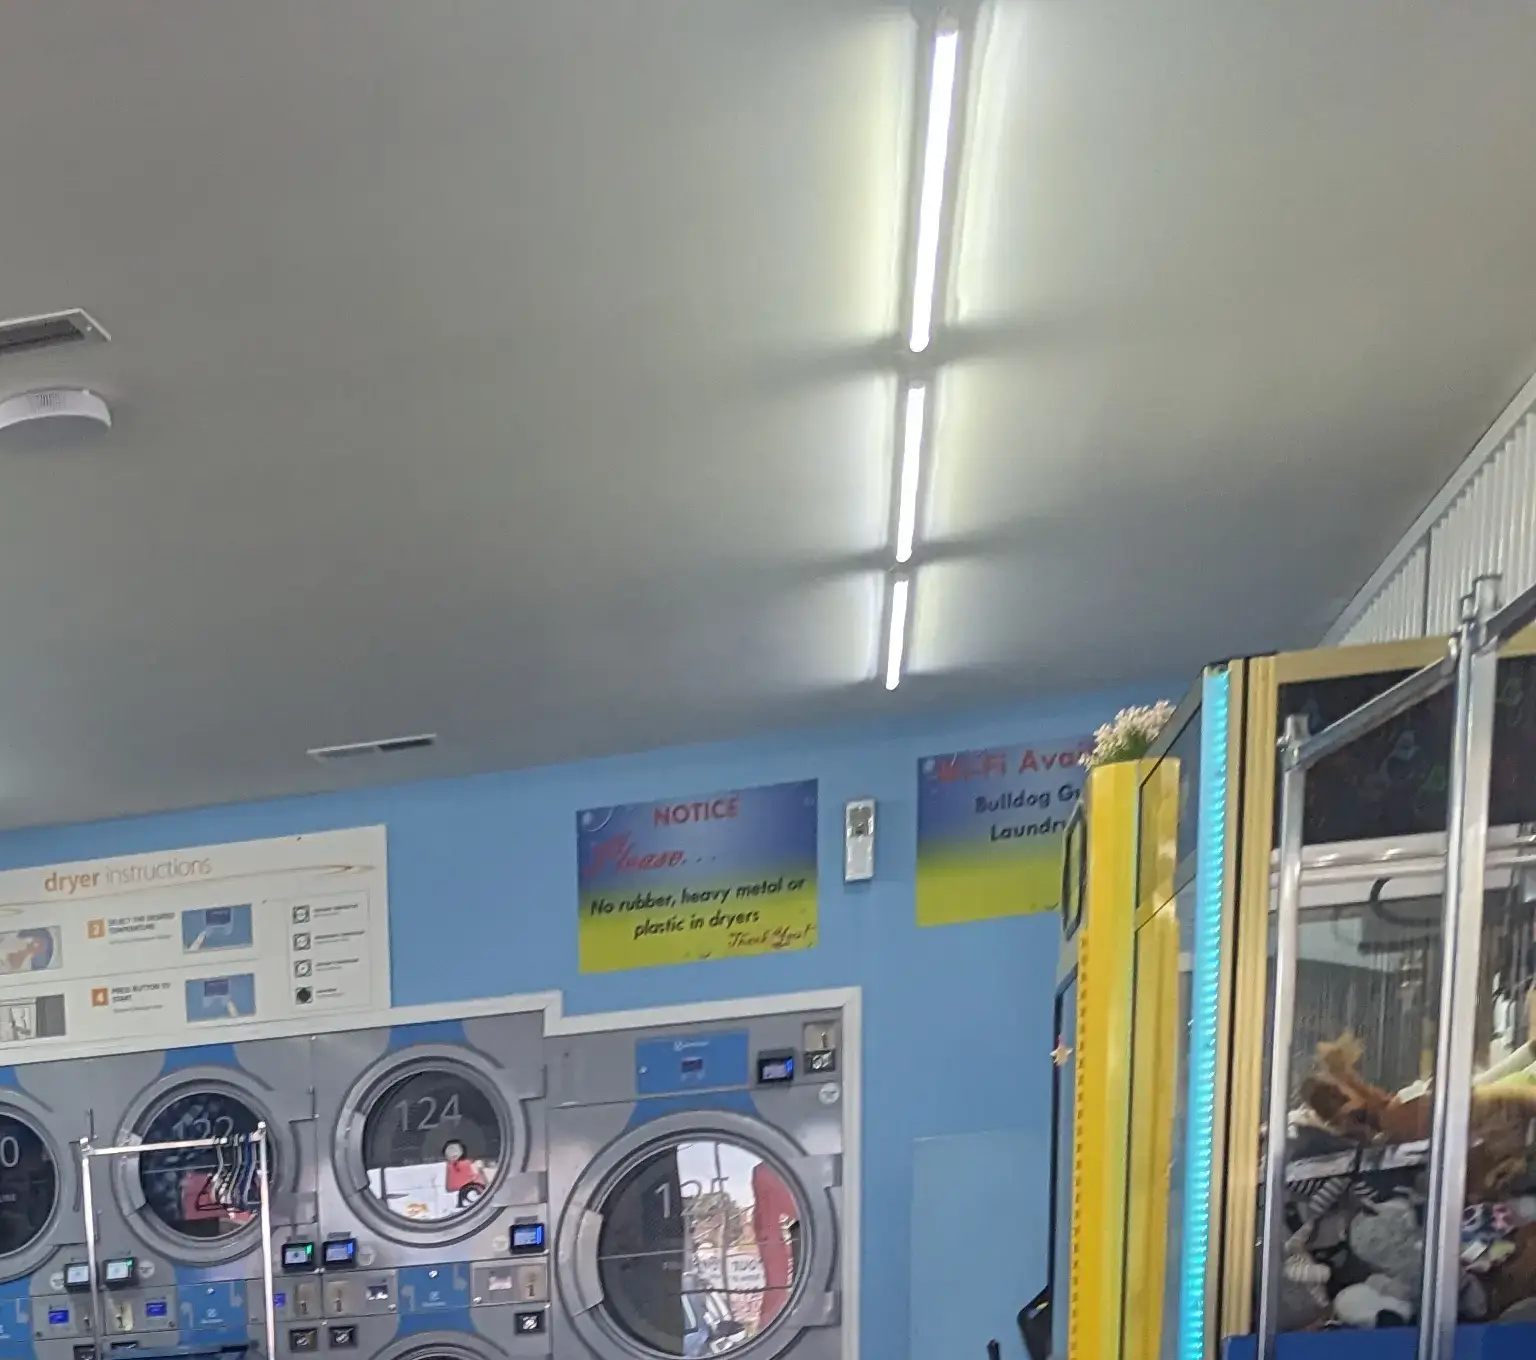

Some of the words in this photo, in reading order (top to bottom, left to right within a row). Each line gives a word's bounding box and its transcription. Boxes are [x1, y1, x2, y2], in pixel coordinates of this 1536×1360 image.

[653, 795, 740, 827] NOTICE
[974, 789, 1052, 813] Bulldog
[990, 816, 1066, 841] Laundr
[44, 868, 101, 895] dryer
[105, 857, 212, 886] instructions
[590, 898, 616, 916] No
[618, 891, 676, 913] rubber,
[680, 887, 732, 905] heavy
[735, 876, 783, 899] metal
[787, 878, 807, 891] or
[93, 924, 100, 936] 2
[633, 914, 685, 940] plastic
[689, 912, 705, 929] in
[709, 908, 761, 929] dryers
[97, 992, 104, 1003] 4
[394, 1094, 463, 1132] 124
